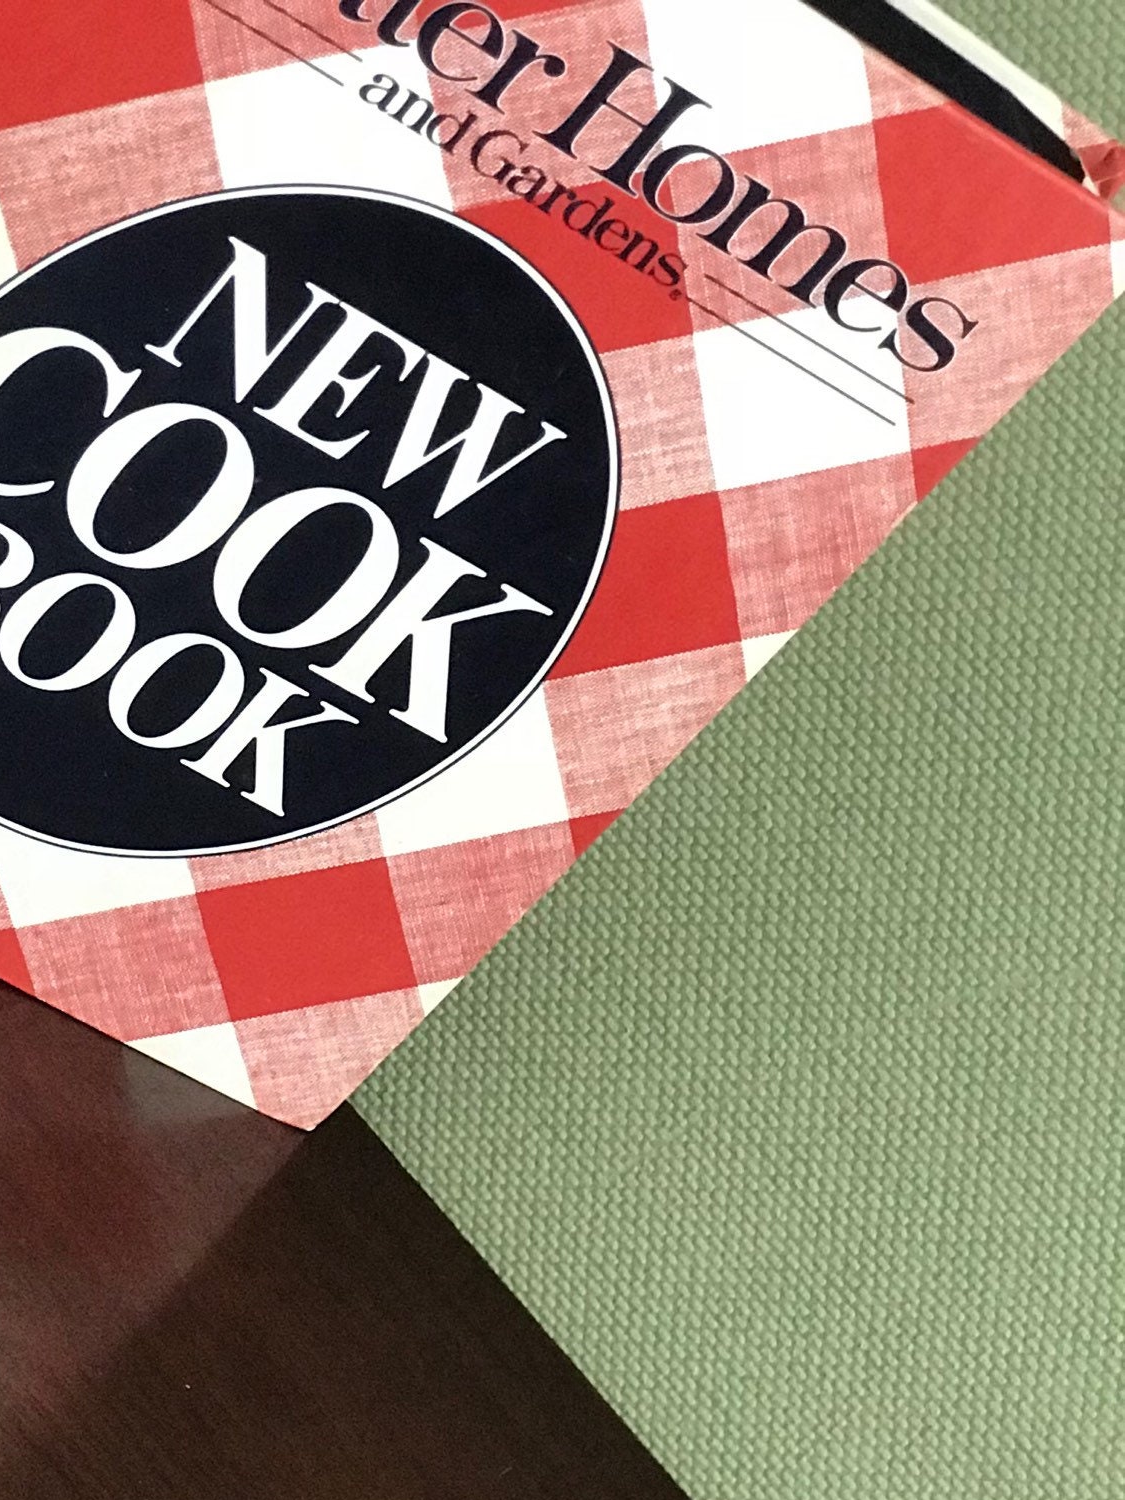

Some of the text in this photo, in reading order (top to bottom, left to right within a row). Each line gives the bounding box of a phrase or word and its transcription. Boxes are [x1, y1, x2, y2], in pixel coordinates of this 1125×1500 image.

[338, 0, 979, 373] er Homes
[358, 73, 478, 154] and
[145, 236, 567, 519] NEW
